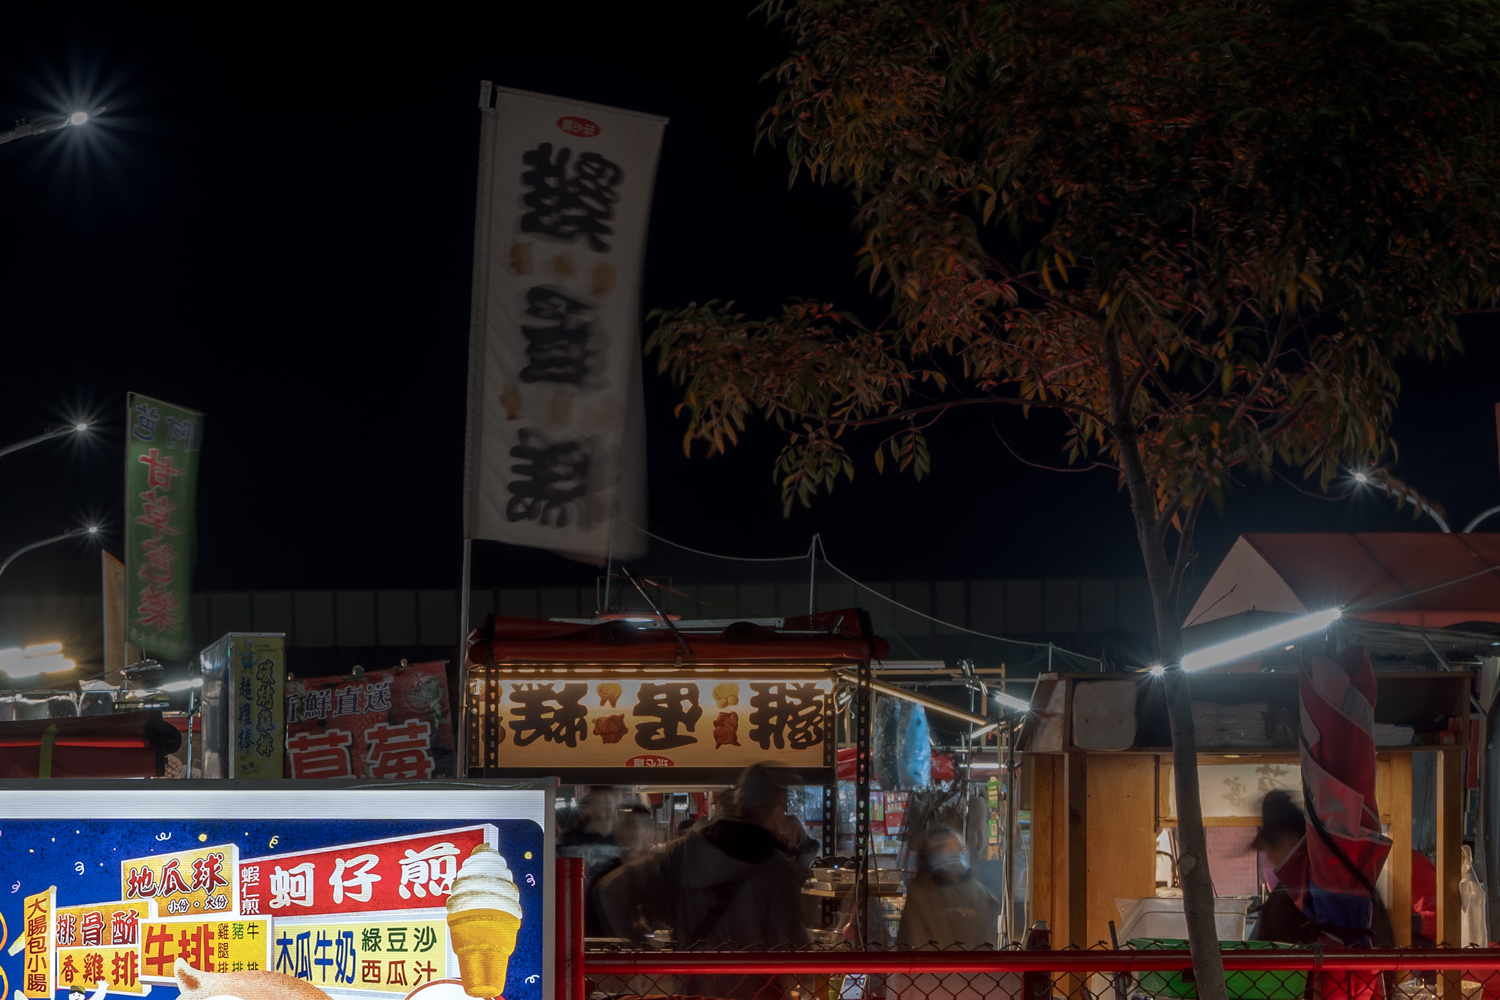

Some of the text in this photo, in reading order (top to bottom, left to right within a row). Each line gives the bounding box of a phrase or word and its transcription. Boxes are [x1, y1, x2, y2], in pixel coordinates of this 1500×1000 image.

[126, 852, 229, 899] 地瓜球
[241, 865, 260, 916] 蝦仁煎
[268, 842, 461, 910] 蚵仔煎
[27, 897, 48, 993] 大腸包小腸
[56, 908, 139, 946] 排骨酥
[144, 923, 216, 976] 牛排
[361, 926, 438, 953] 綠豆沙
[60, 950, 139, 988] 香雞排
[275, 929, 357, 985] 木瓜牛奶
[361, 959, 438, 987] 西瓜汁
